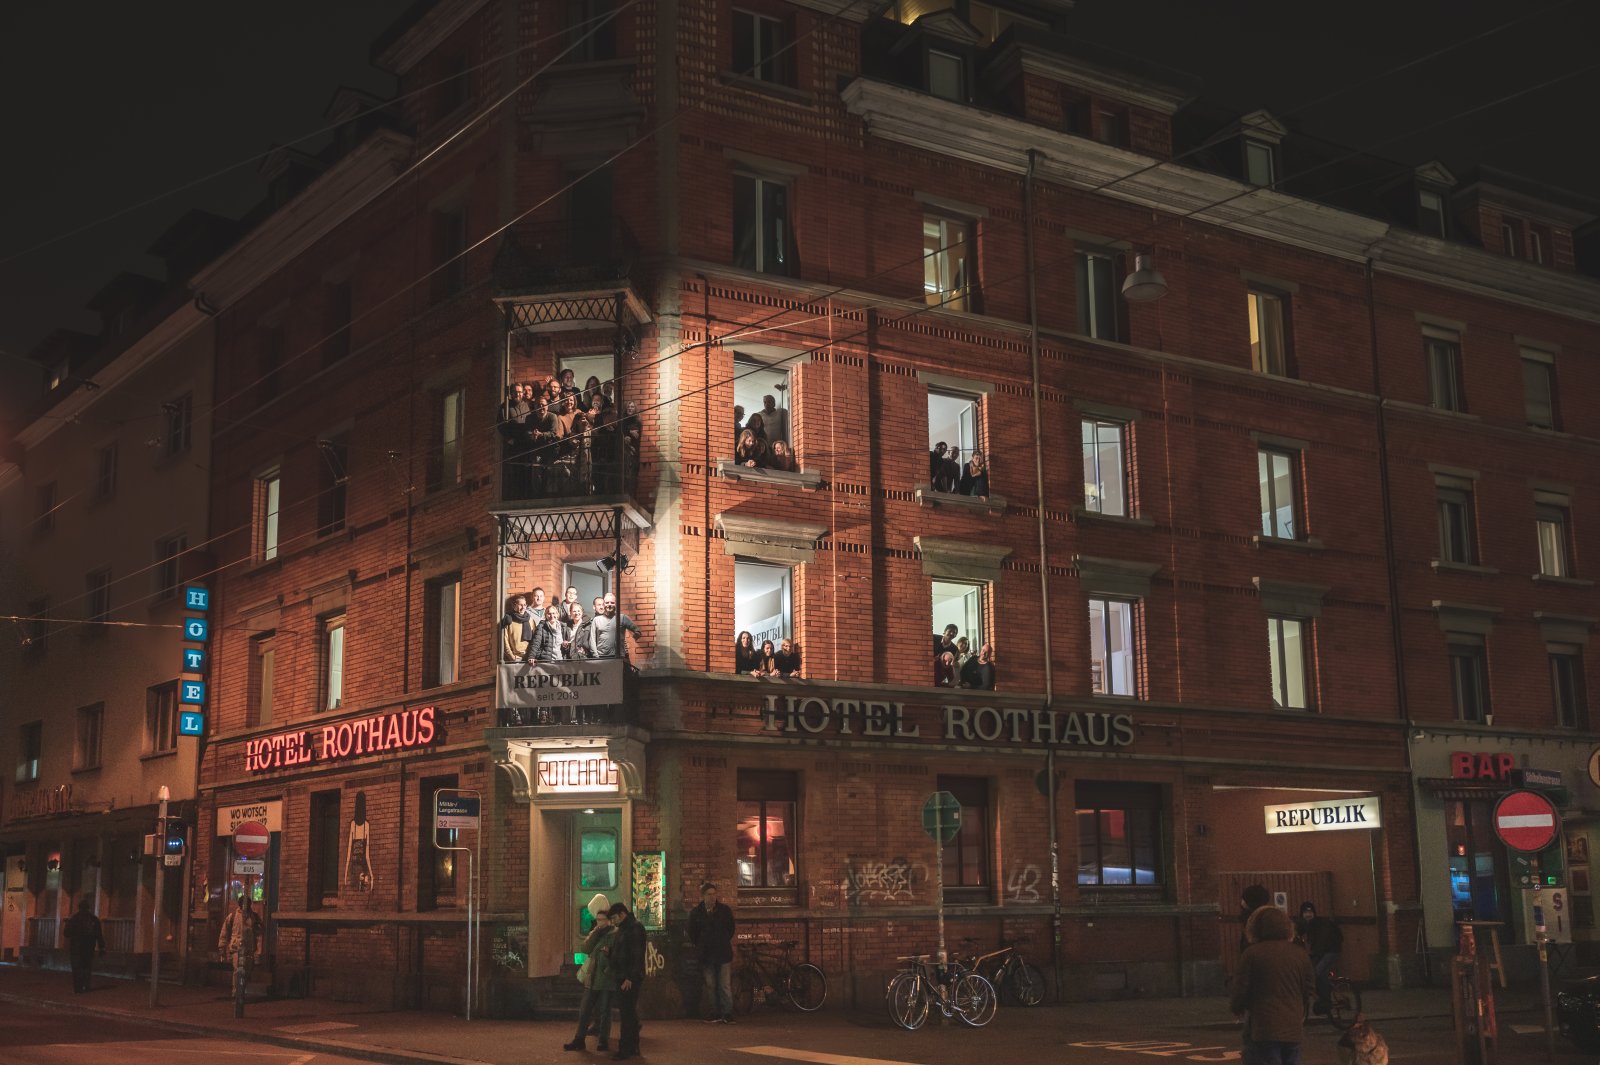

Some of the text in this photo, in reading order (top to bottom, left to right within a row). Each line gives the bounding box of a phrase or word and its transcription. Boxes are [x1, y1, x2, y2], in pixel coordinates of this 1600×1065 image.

[184, 591, 206, 731] HOTEL
[514, 672, 601, 689] REPUBLIK
[537, 691, 579, 701] seit 2018
[763, 694, 1134, 747] HOTEL ROTHAUS
[245, 706, 435, 771] HOTEL ROTHAUS
[538, 758, 620, 786] ROTCHAOS
[230, 806, 267, 819] WO WOTSCH
[1276, 804, 1367, 827] REPUBLIK
